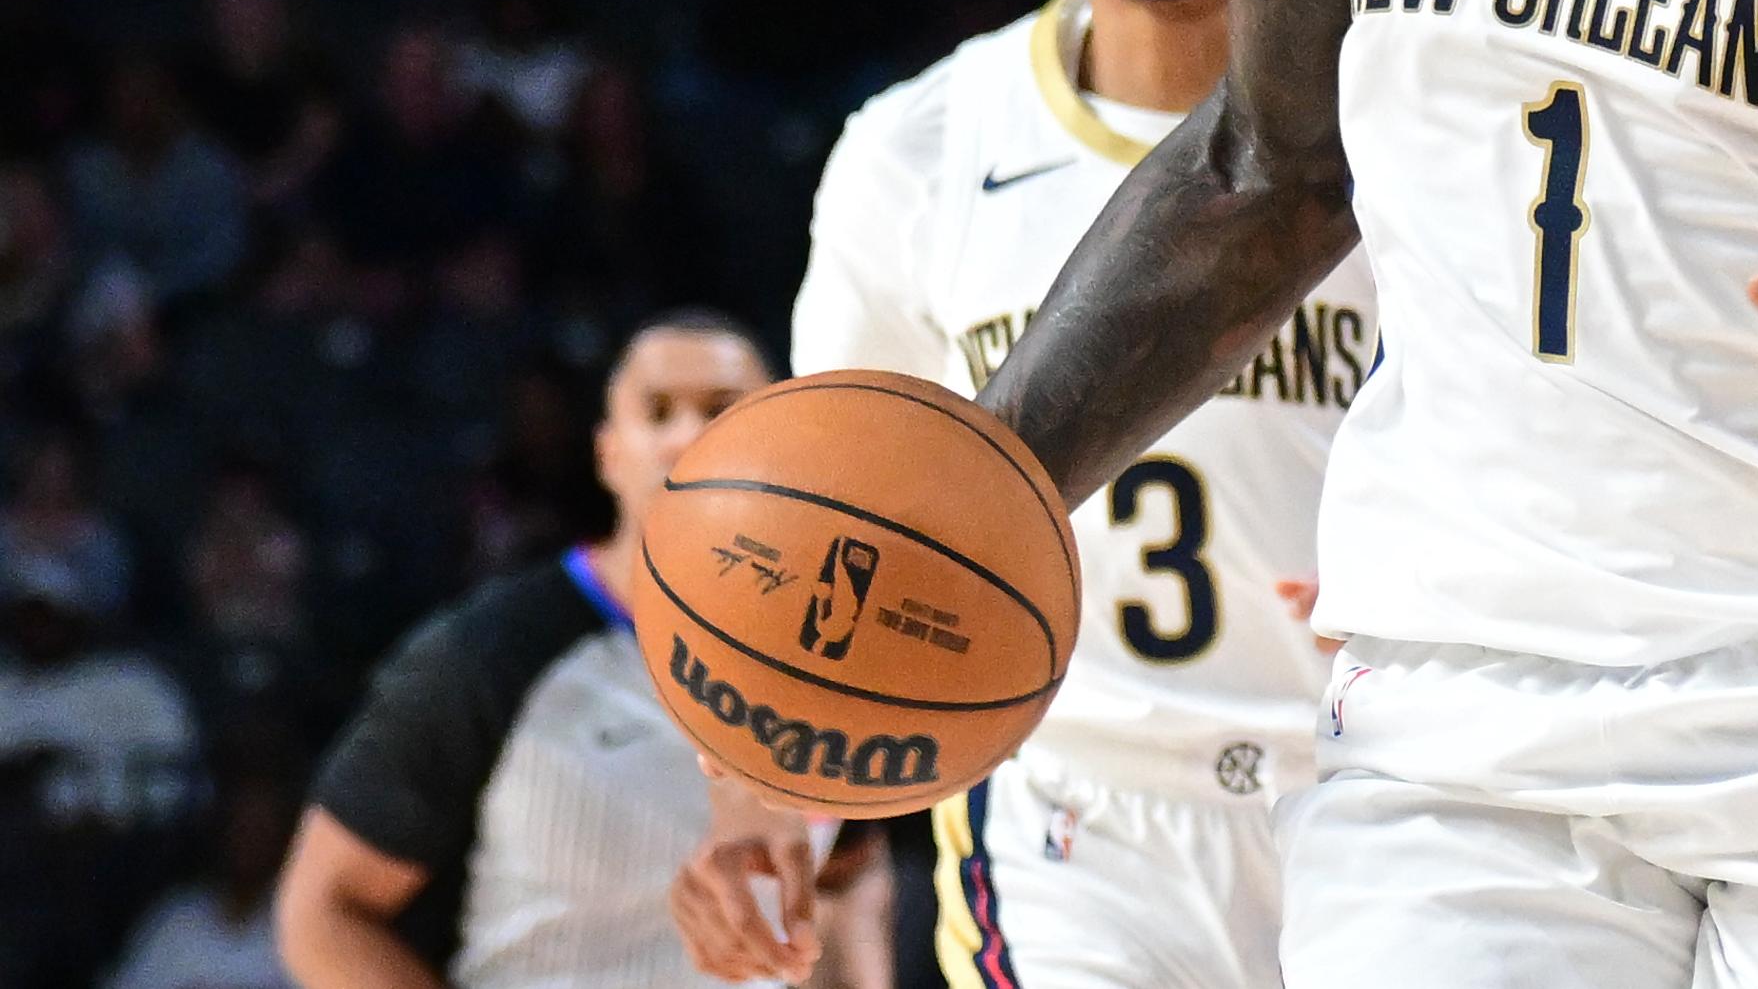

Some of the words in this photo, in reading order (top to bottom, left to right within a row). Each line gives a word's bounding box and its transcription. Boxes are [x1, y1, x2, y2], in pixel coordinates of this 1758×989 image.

[1522, 80, 1592, 364] 1
[1108, 453, 1225, 666] 3
[669, 632, 939, 787] Wilson
